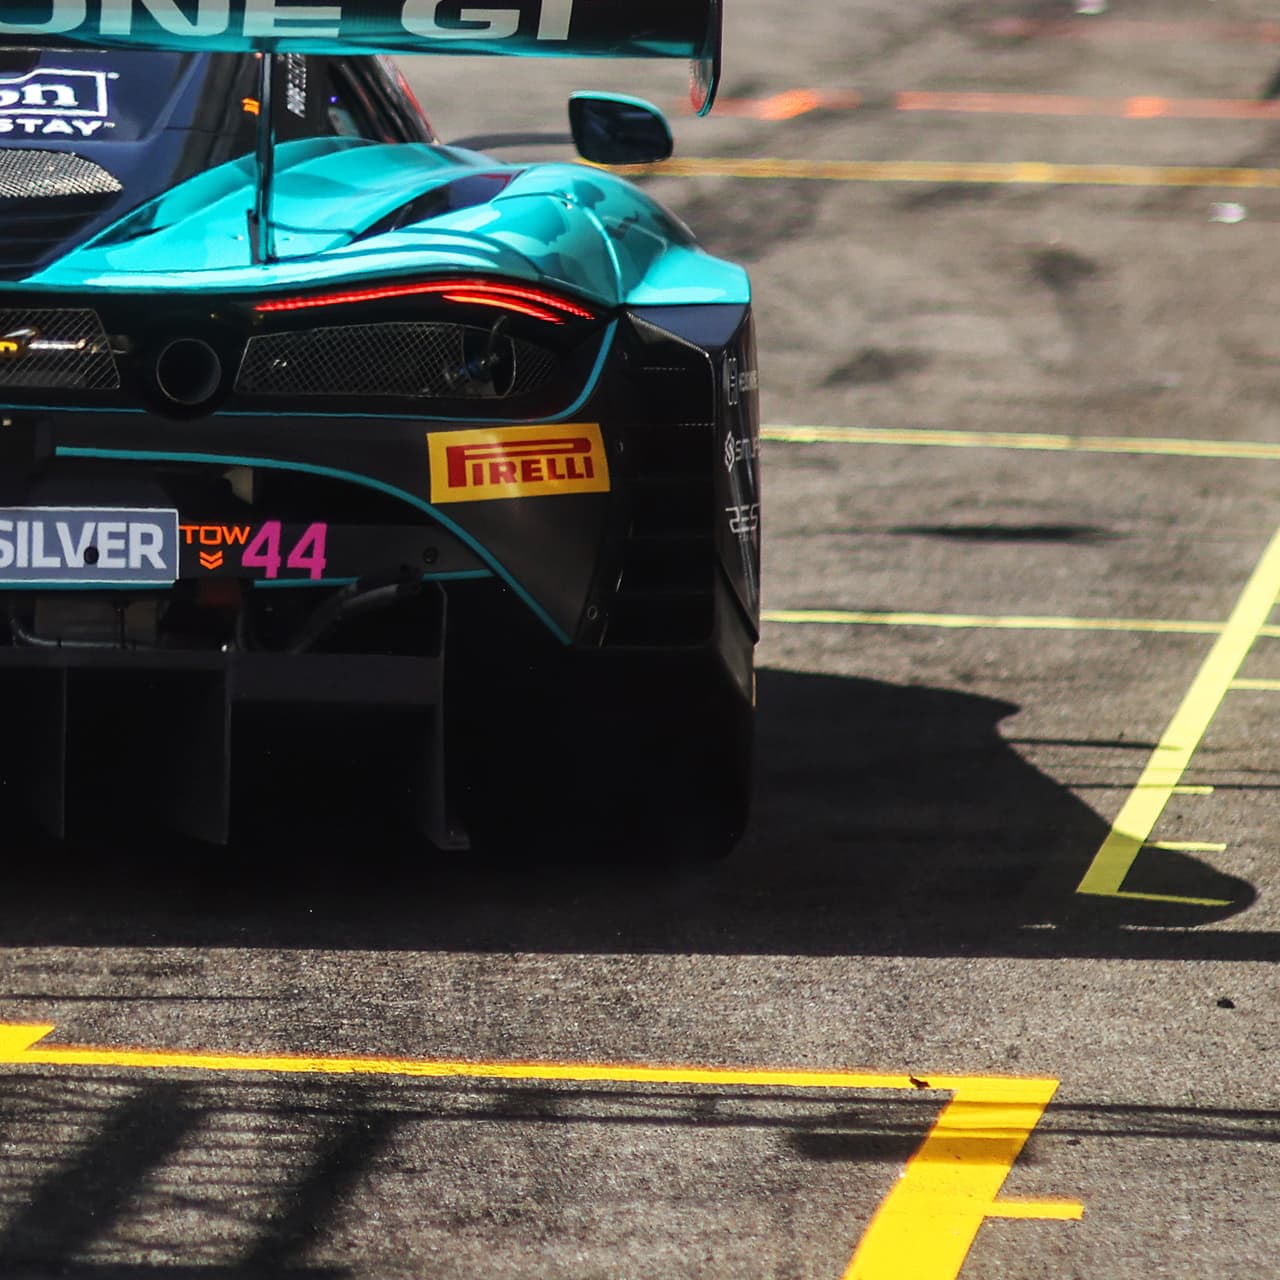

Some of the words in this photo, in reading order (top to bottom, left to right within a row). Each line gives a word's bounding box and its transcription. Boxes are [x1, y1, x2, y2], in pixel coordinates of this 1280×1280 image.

[446, 437, 595, 488] PIRELLI
[178, 524, 251, 546] TOW
[241, 520, 328, 579] 44
